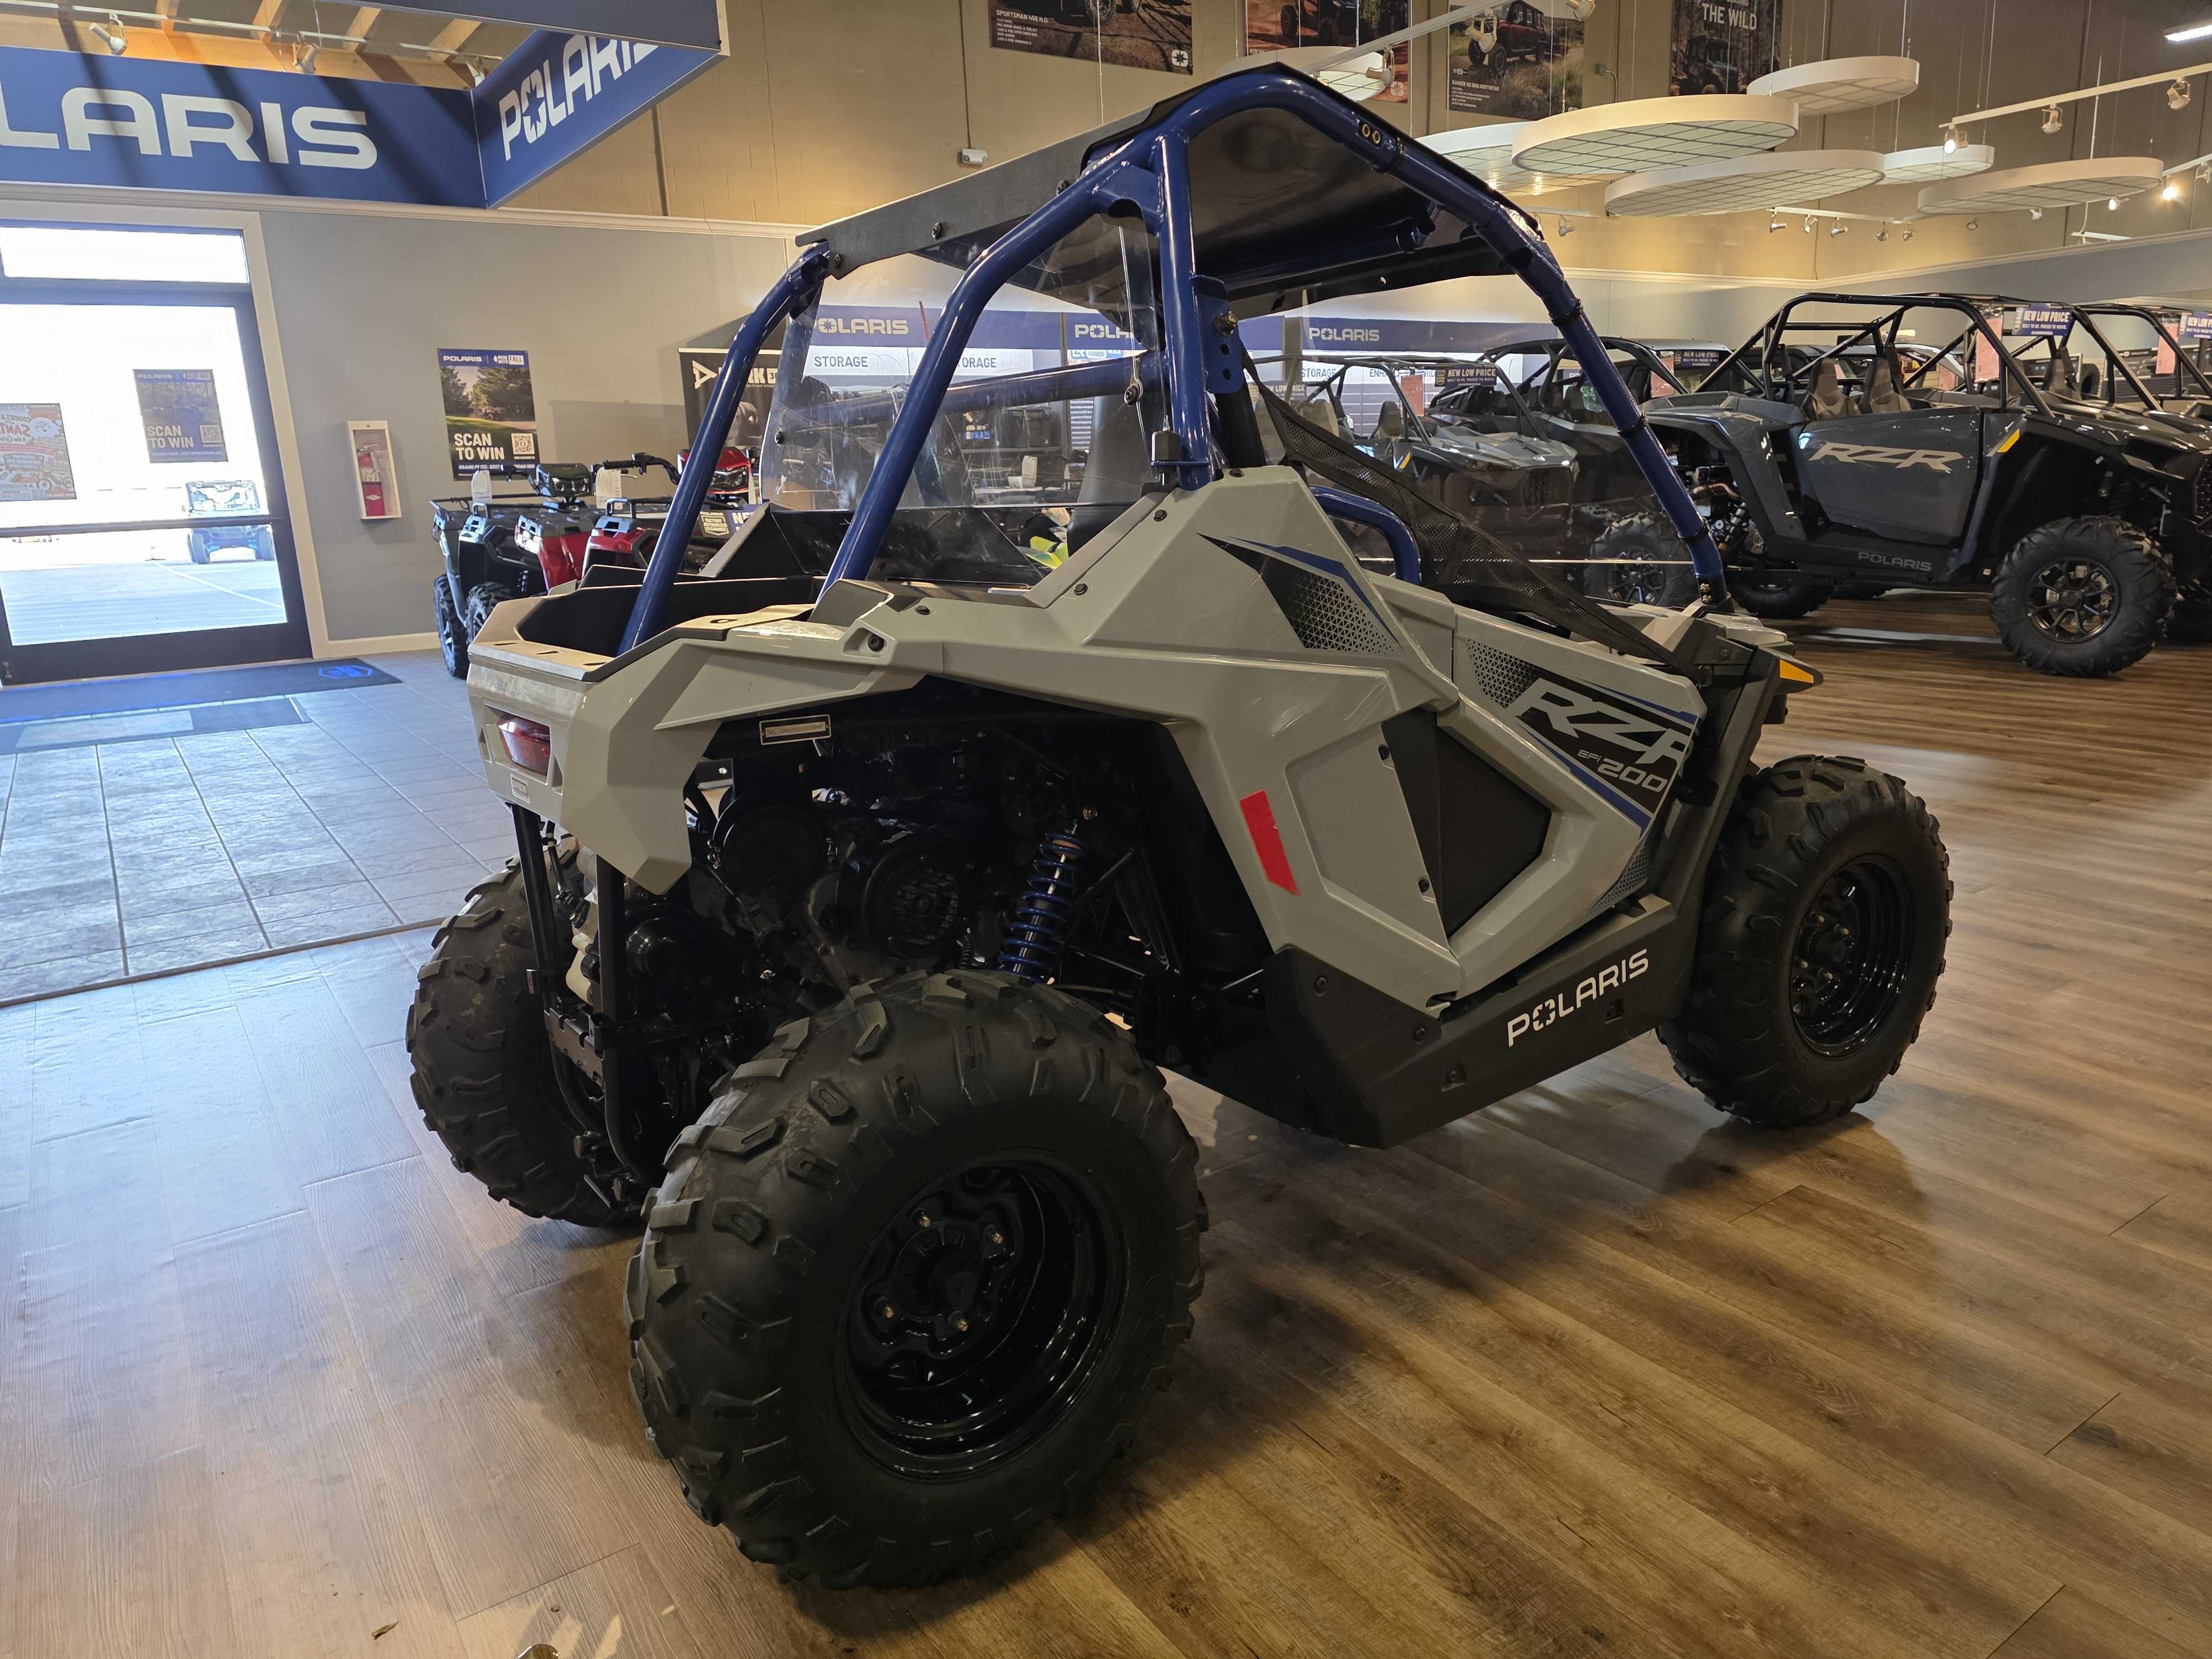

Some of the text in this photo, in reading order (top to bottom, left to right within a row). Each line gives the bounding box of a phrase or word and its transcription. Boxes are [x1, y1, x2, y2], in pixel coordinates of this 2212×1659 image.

[996, 9, 1027, 20] SPORTSMAN
[1702, 3, 1757, 30] THE WILD
[2023, 310, 2037, 321] NEW
[2037, 311, 2050, 321] LOW
[2050, 311, 2070, 322] PRICE
[815, 318, 909, 335] OLARIS
[1074, 324, 1134, 338] POLA
[1308, 327, 1380, 342] POLARIS
[814, 356, 869, 367] STORAGE
[958, 358, 997, 368] ORAGE
[1301, 368, 1337, 377] STORAGE
[147, 425, 182, 437] SCAN
[149, 436, 194, 448] TO WIN
[454, 433, 492, 446] SCAN
[456, 447, 505, 460] TO WIN
[1808, 441, 1964, 471] RZR
[732, 512, 755, 524] NE
[1858, 552, 1932, 572] POLARIS
[1505, 677, 1694, 778] RZR
[1578, 749, 1668, 792] EFI 200
[1507, 948, 1648, 1047] POLARIS
